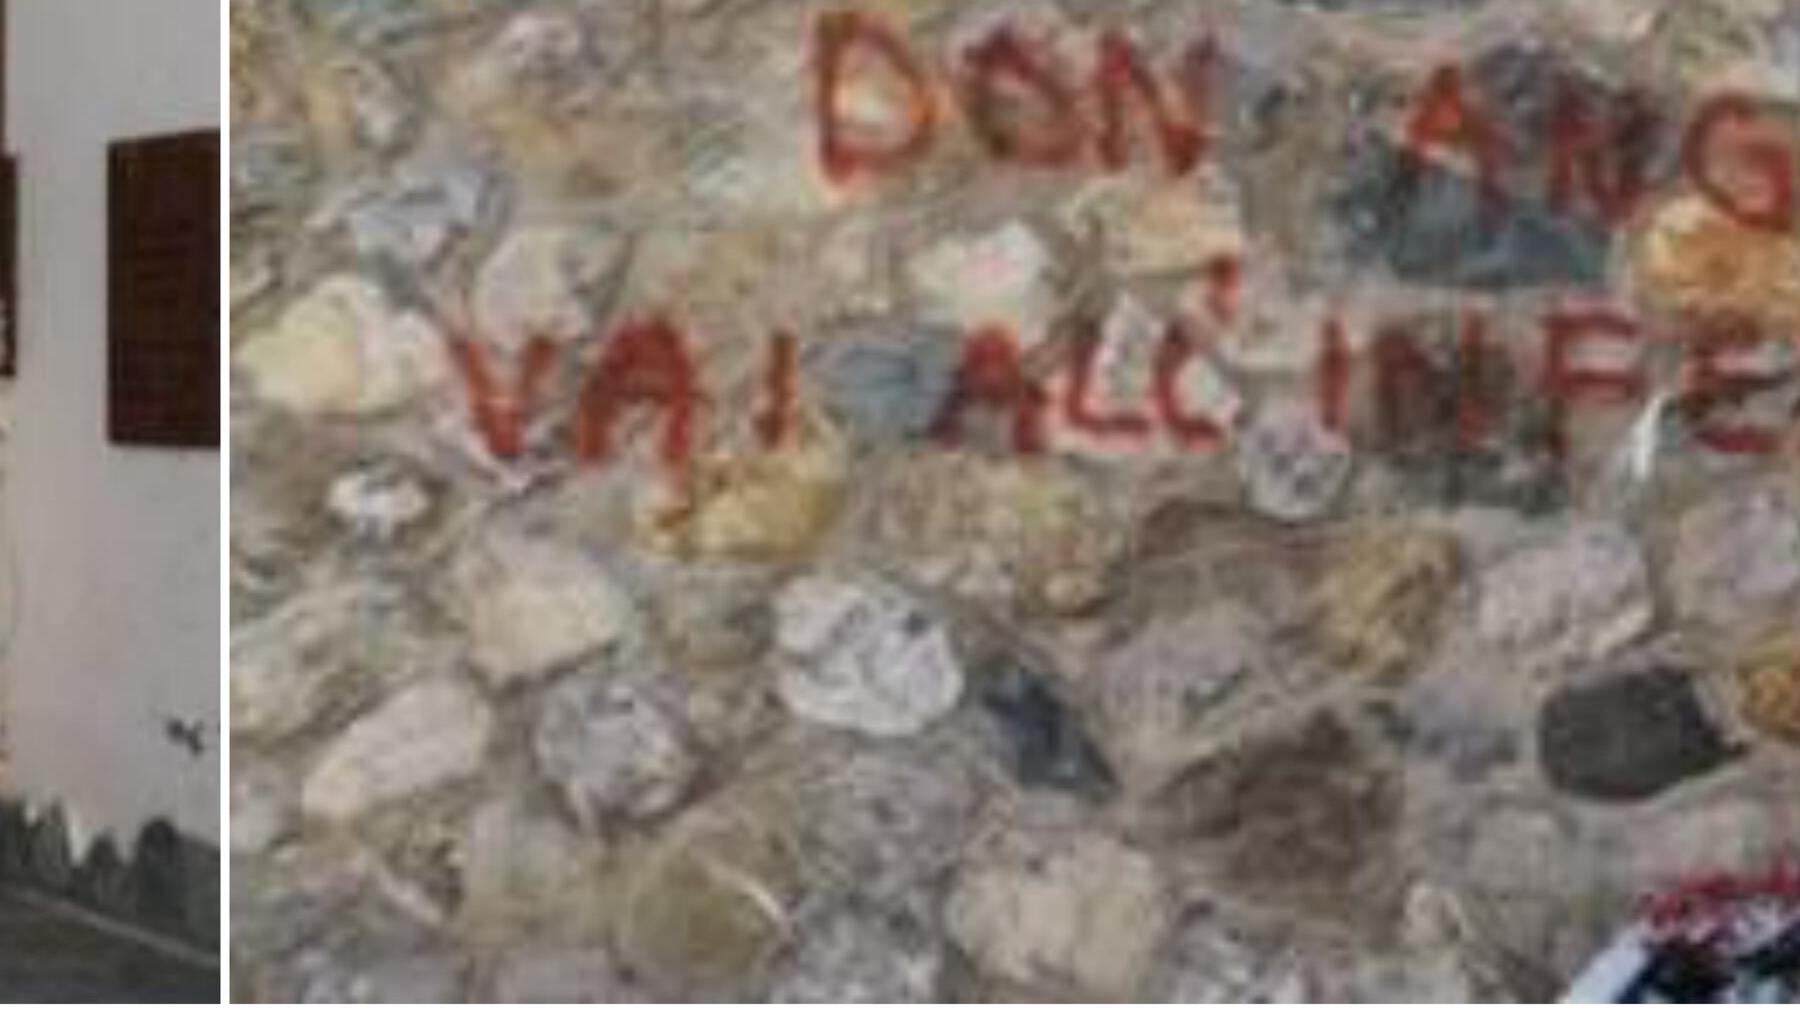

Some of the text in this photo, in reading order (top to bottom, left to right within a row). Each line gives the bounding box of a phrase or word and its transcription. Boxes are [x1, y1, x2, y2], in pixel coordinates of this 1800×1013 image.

[818, 11, 1794, 233] DON ANG
[447, 313, 800, 463] VAI
